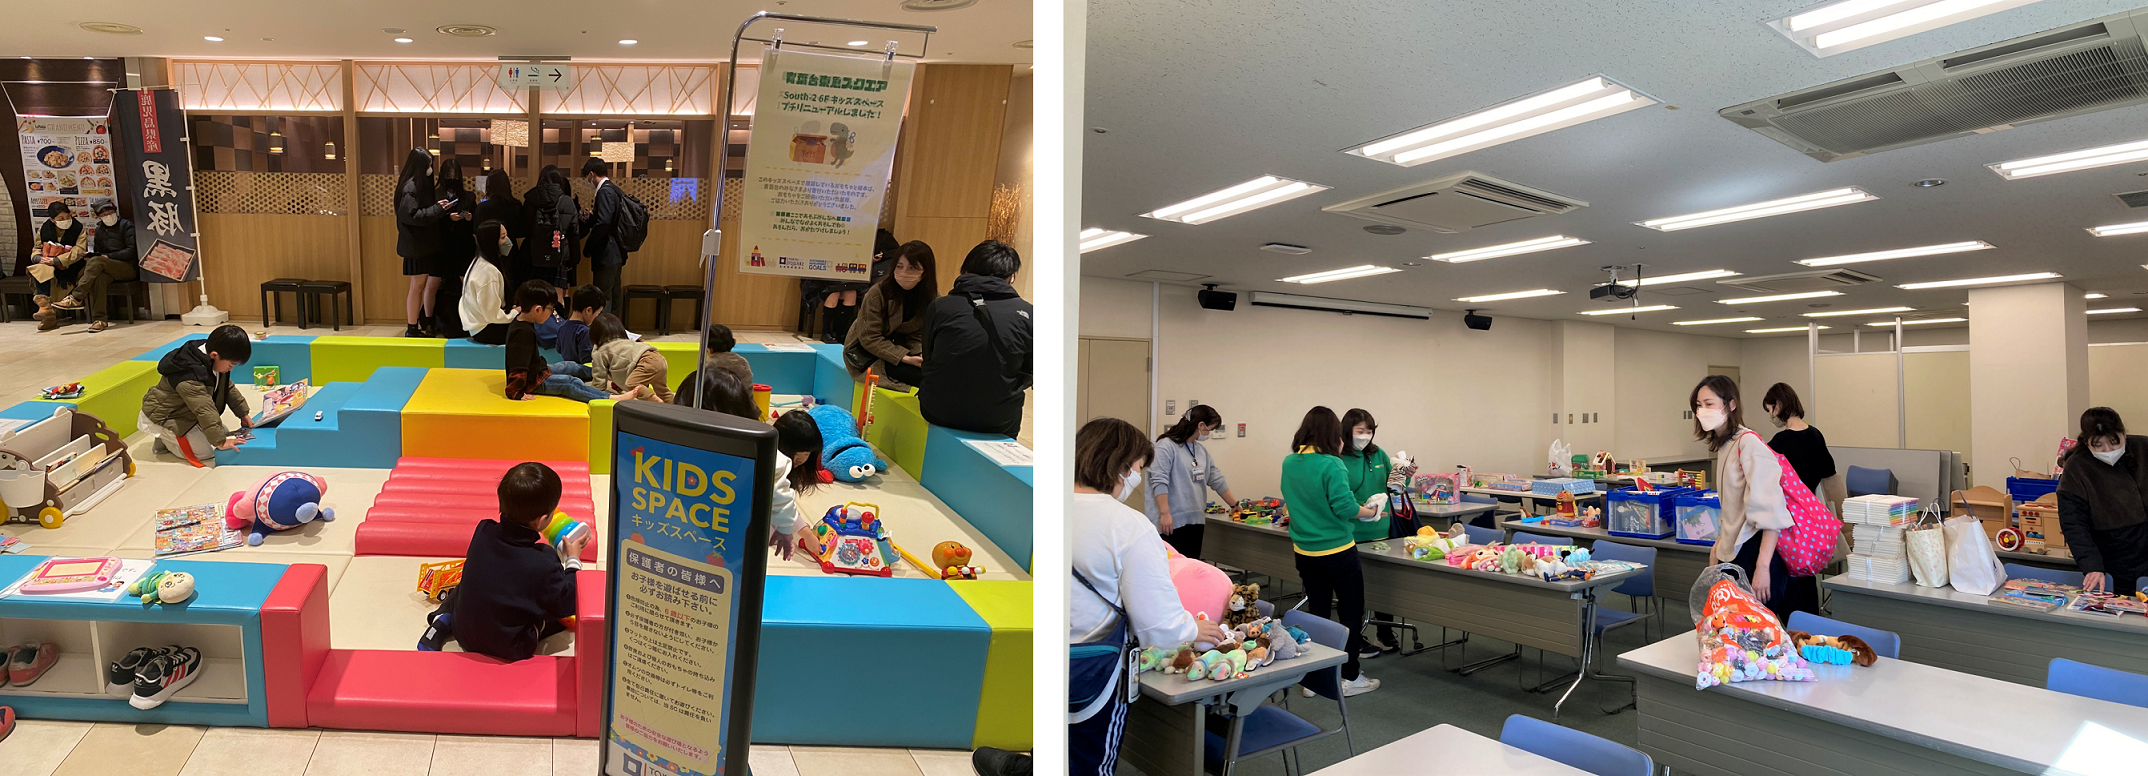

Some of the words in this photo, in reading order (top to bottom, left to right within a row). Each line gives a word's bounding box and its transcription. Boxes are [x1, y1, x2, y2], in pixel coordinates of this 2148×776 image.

[785, 71, 888, 92] 青葉台東急スクエア
[831, 95, 884, 108] キッズスペース
[802, 150, 817, 158] TOYS
[634, 451, 737, 505] KIDS
[631, 486, 730, 533] SPACE
[631, 513, 726, 551] キッズスペース
[629, 552, 720, 589] 保護者の皆様へ
[631, 572, 718, 607] お子様を遊ばせる前に
[640, 585, 712, 615] 必ずお読み下さい。
